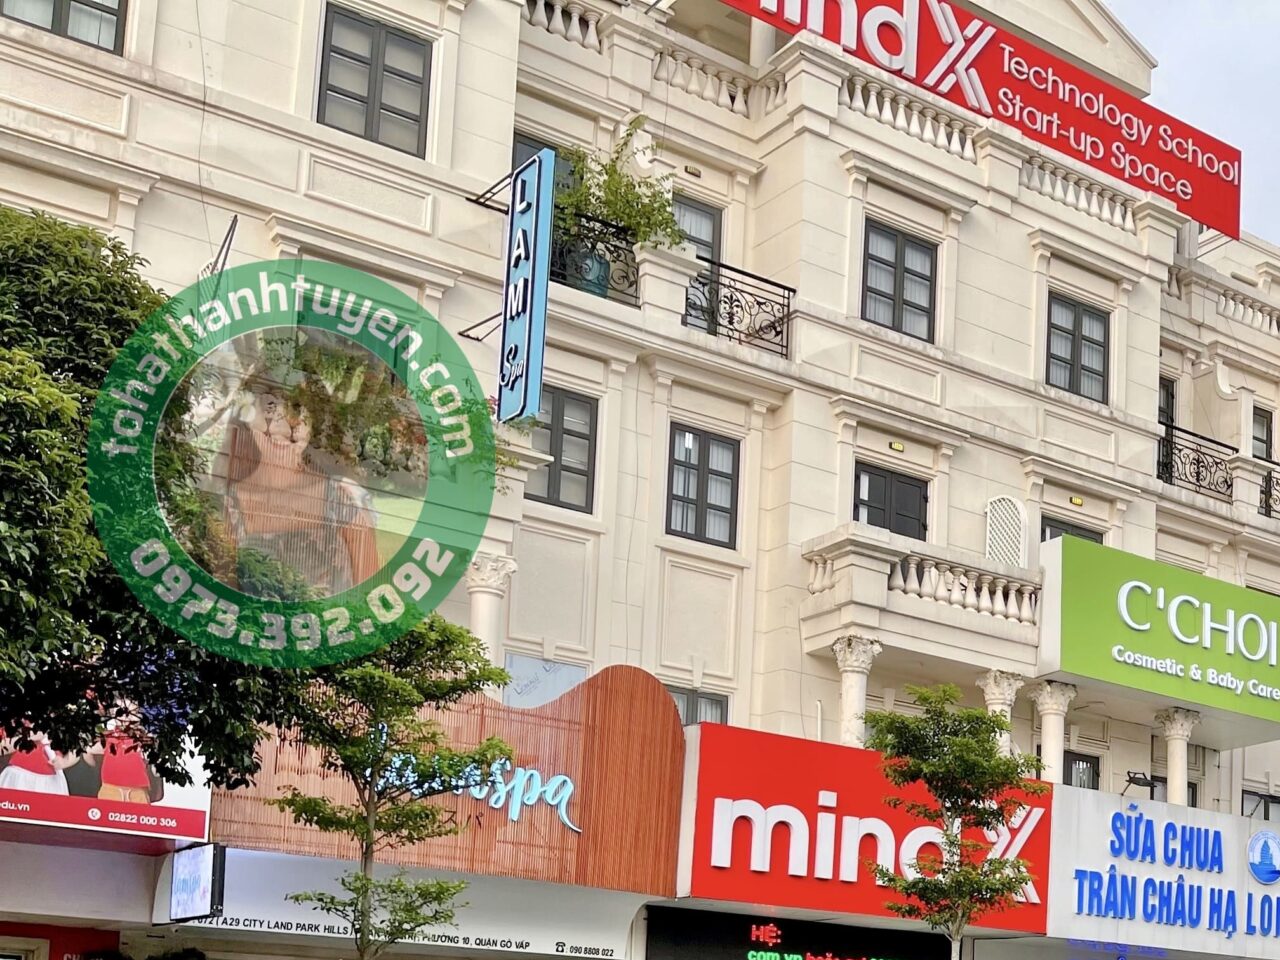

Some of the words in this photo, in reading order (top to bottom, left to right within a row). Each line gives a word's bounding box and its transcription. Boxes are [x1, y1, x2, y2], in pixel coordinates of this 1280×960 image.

[998, 87, 1104, 161] Start-up
[1110, 142, 1193, 201] Space
[1000, 43, 1153, 146] Technology
[1158, 125, 1239, 185] School
[507, 178, 531, 321] LAM
[500, 344, 524, 391] Spa
[1117, 580, 1278, 666] C'CHOI
[1112, 644, 1185, 678] Cosmetic
[1189, 664, 1203, 682] &
[1207, 667, 1244, 695] Baby
[1248, 679, 1280, 701] Care
[108, 812, 138, 824] 02822
[140, 816, 158, 826] 000
[1110, 803, 1157, 864] SỮA
[1163, 822, 1224, 873] CHUA
[243, 918, 264, 928] CITY
[267, 921, 293, 930] LAND
[296, 922, 320, 932] PARK
[1073, 864, 1137, 920] TRÂN
[1143, 874, 1203, 928] CHÂU
[1207, 887, 1237, 938] HẠ
